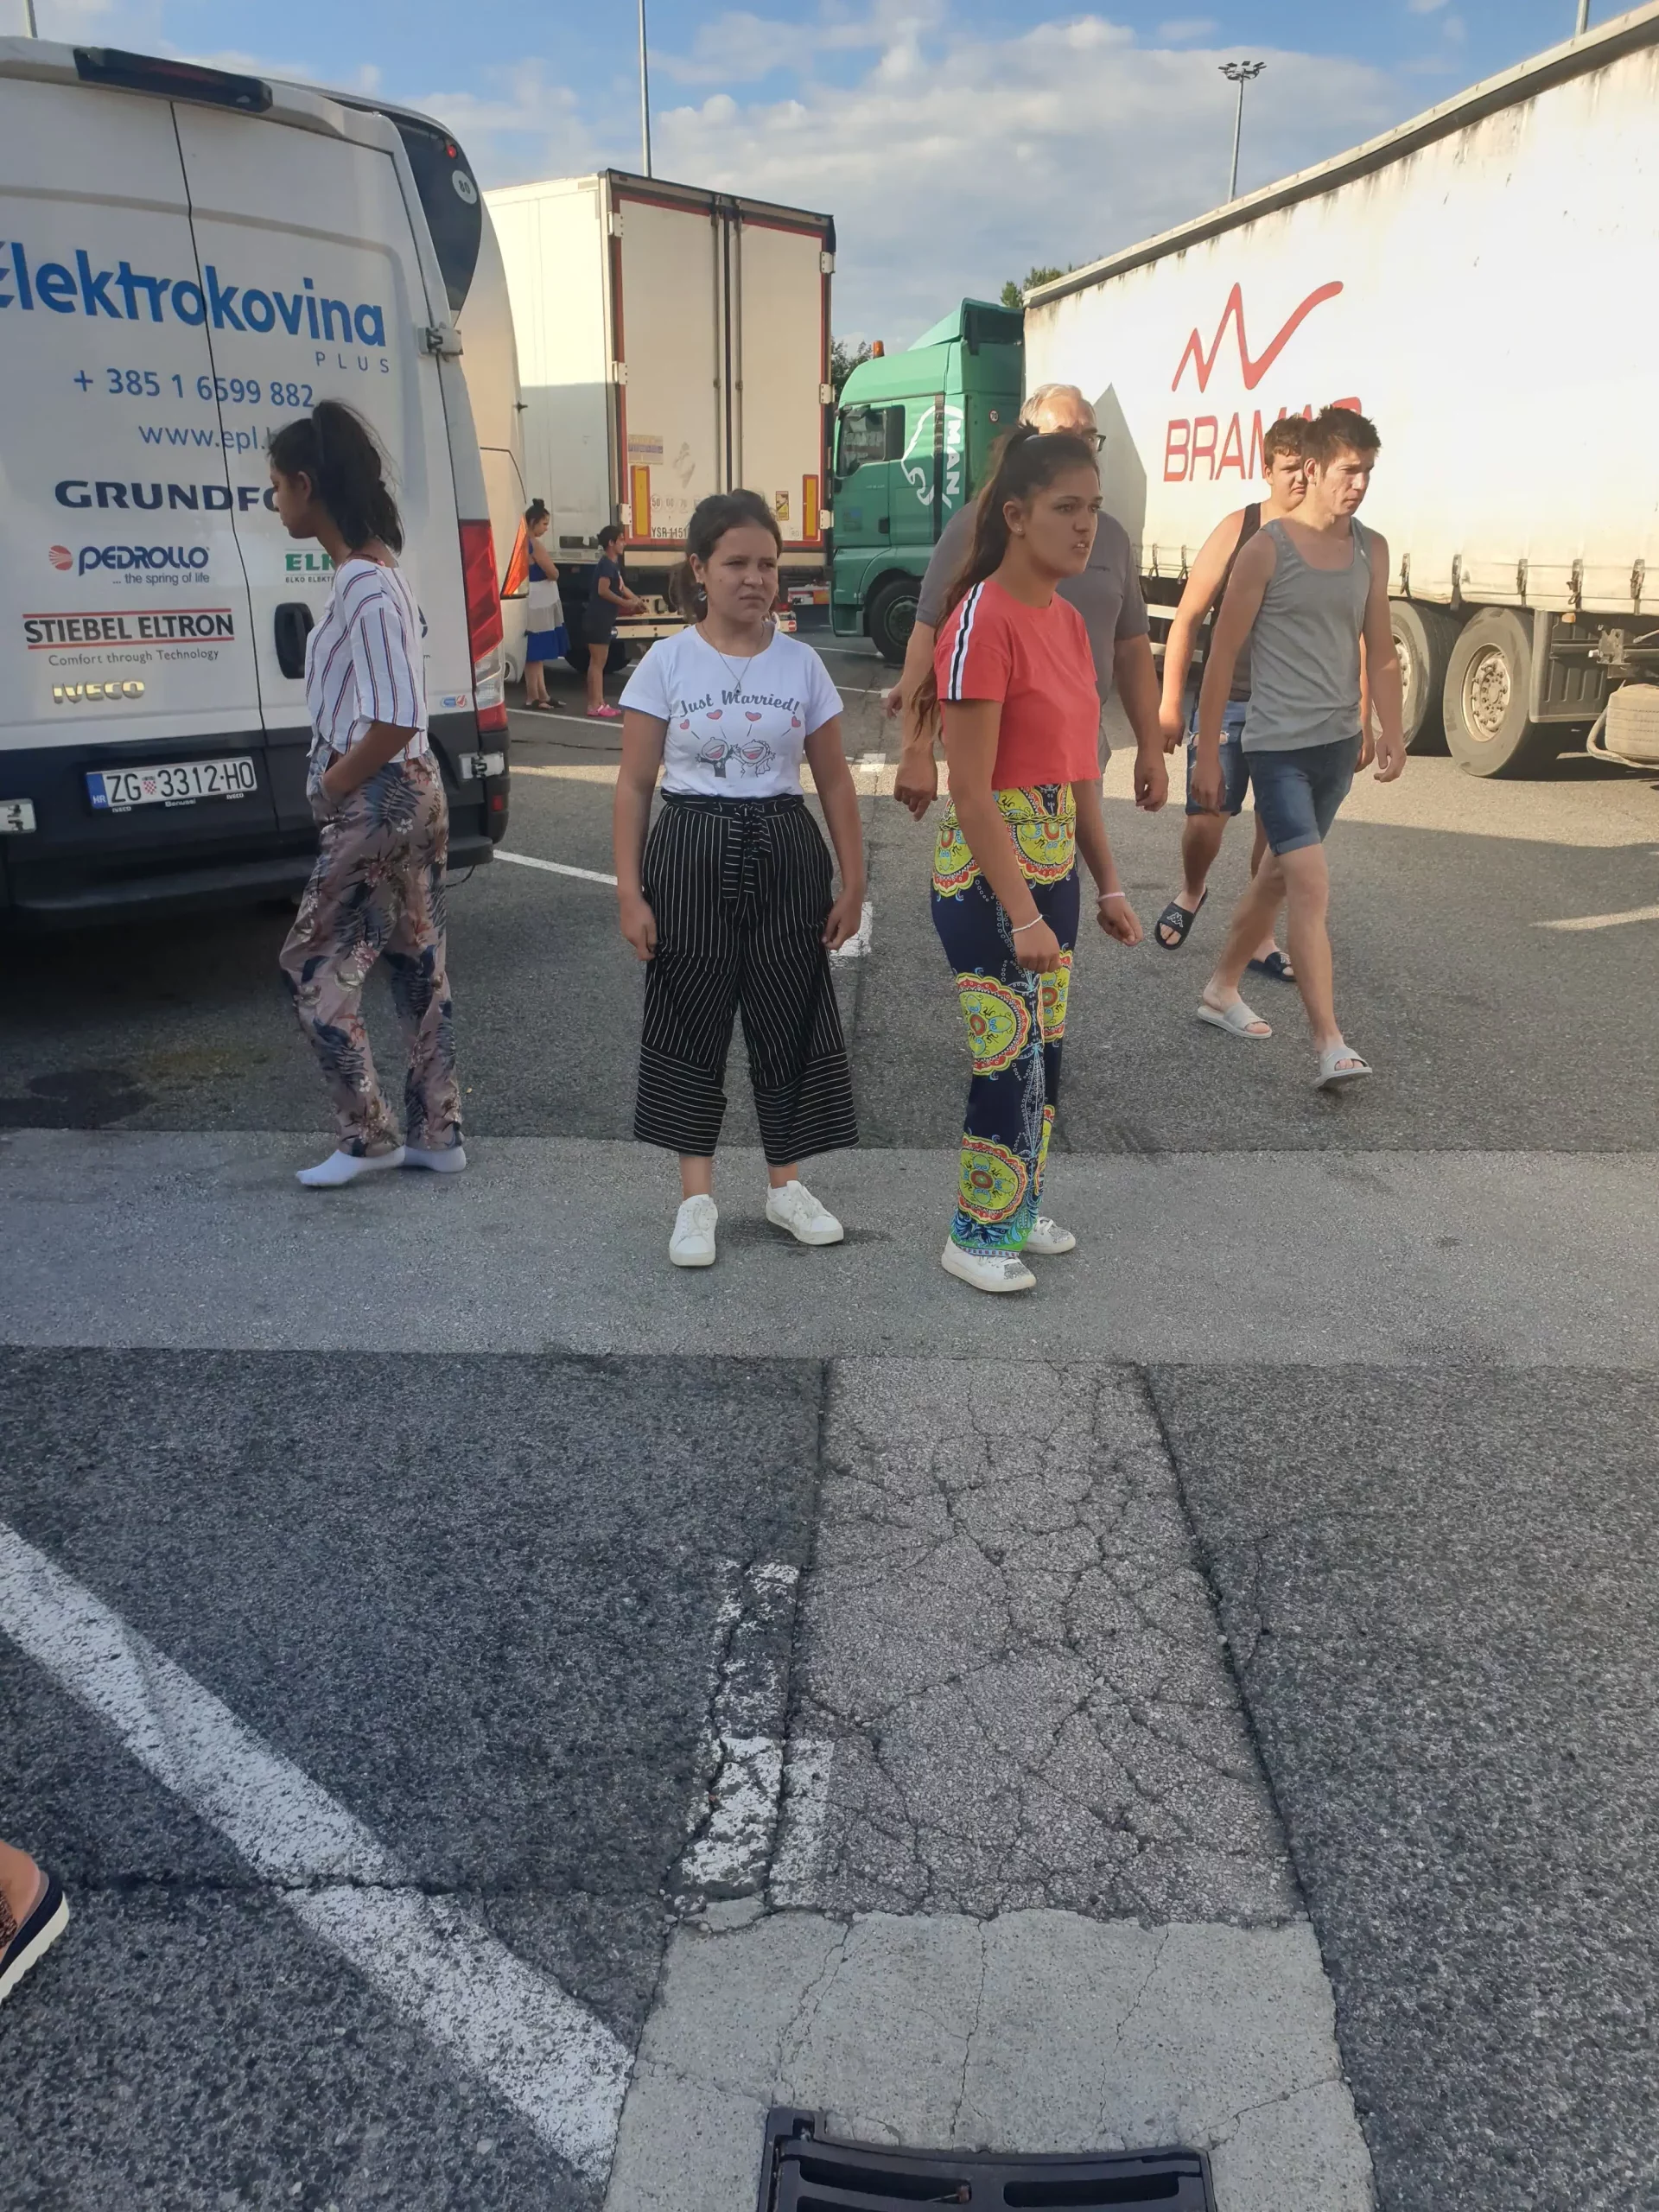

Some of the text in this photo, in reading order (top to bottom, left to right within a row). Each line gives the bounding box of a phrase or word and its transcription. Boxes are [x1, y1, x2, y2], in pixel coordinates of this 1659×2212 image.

[107, 368, 161, 397] 385
[172, 374, 183, 398] 1
[197, 375, 261, 404] 6599
[270, 381, 315, 407] 882
[138, 425, 273, 454] www.epl.
[946, 419, 962, 495] MAN
[54, 480, 280, 512] GRUNDF
[79, 545, 209, 576] PEDROLLO
[285, 553, 336, 571] ELK
[124, 573, 143, 584] the
[145, 573, 179, 587] spring
[181, 572, 193, 583] of
[194, 572, 210, 583] life
[23, 613, 235, 644] STIEBEL ELTRON
[48, 647, 219, 667] Comfort through Technology
[52, 677, 145, 705] IVECO
[679, 693, 714, 718] Just
[92, 795, 107, 804] HR
[106, 772, 142, 804] ZG
